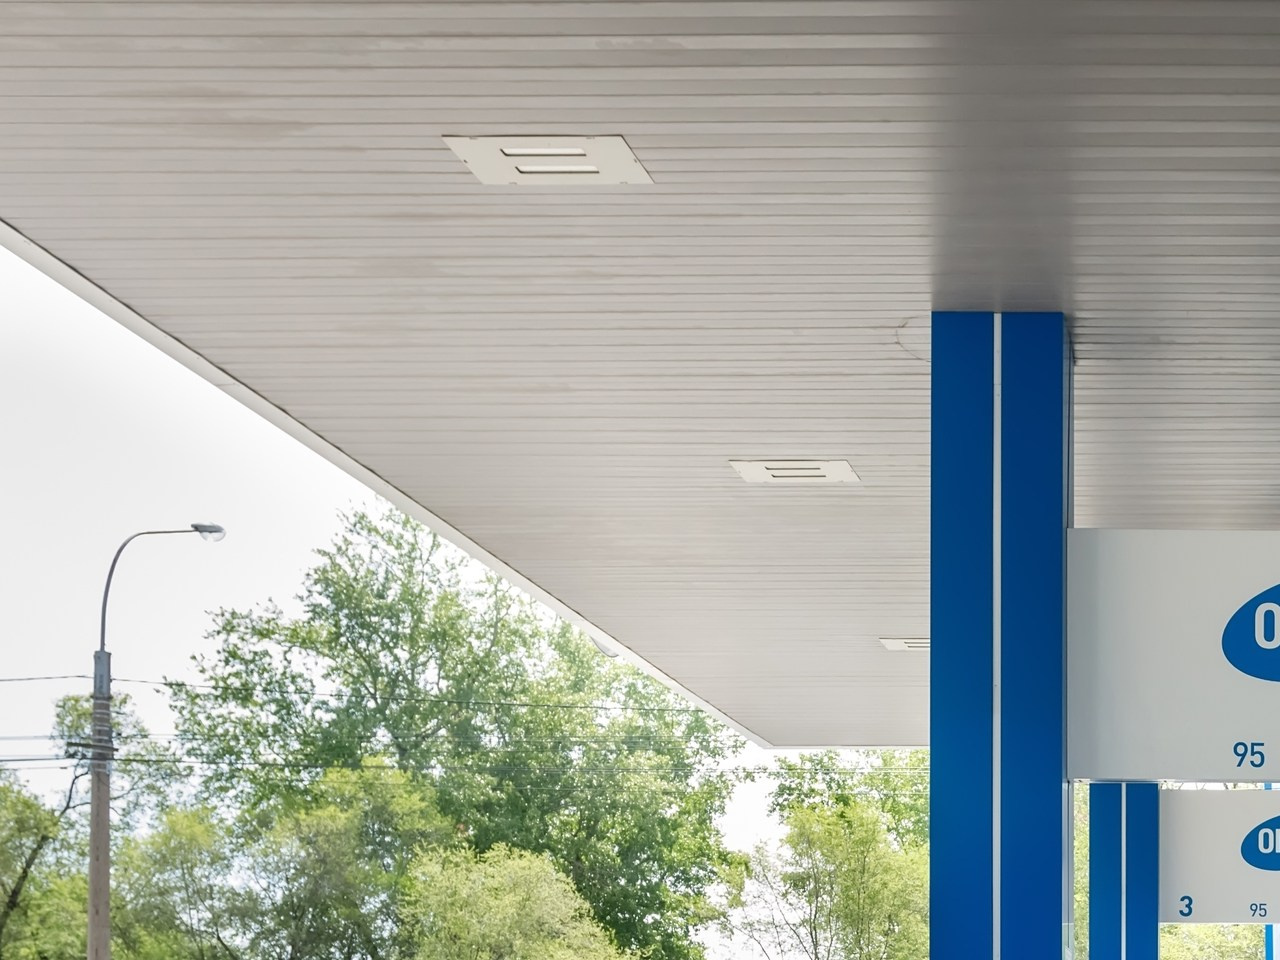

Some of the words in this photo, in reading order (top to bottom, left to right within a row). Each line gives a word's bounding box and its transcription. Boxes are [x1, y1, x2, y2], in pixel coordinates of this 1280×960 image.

[1232, 741, 1266, 769] 95
[1178, 895, 1194, 917] 3
[1249, 903, 1268, 918] 95
